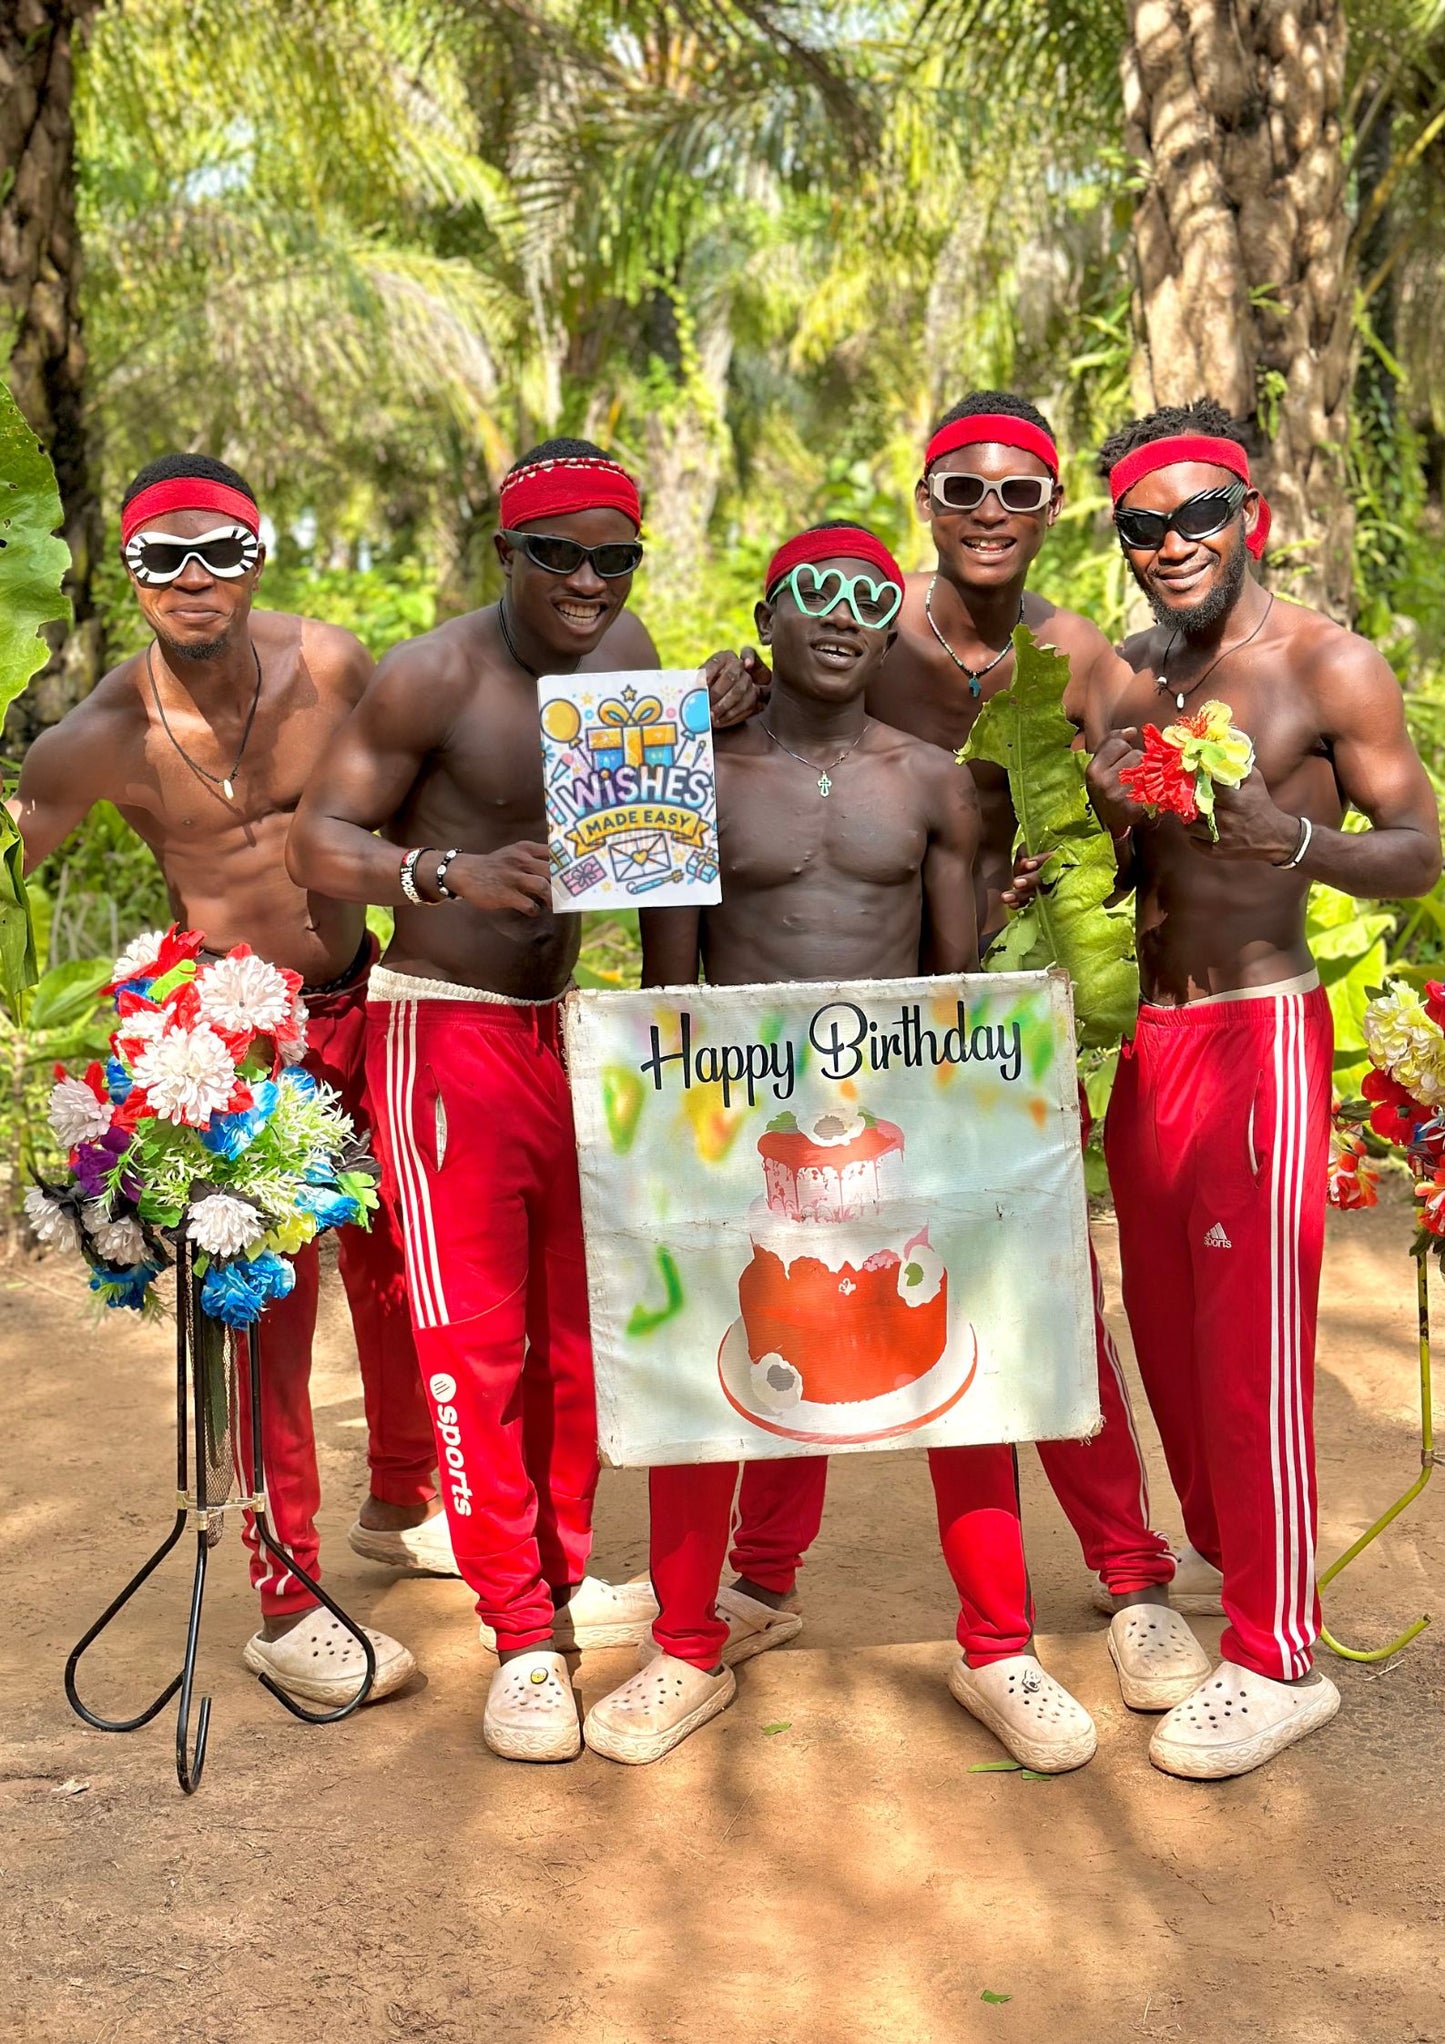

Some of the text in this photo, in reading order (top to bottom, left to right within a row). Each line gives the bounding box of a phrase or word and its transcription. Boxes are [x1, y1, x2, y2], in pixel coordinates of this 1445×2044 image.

[585, 810, 692, 836] MADE EASY
[640, 1000, 1022, 1108] Happy Birthday
[436, 1404, 474, 1517] sports
